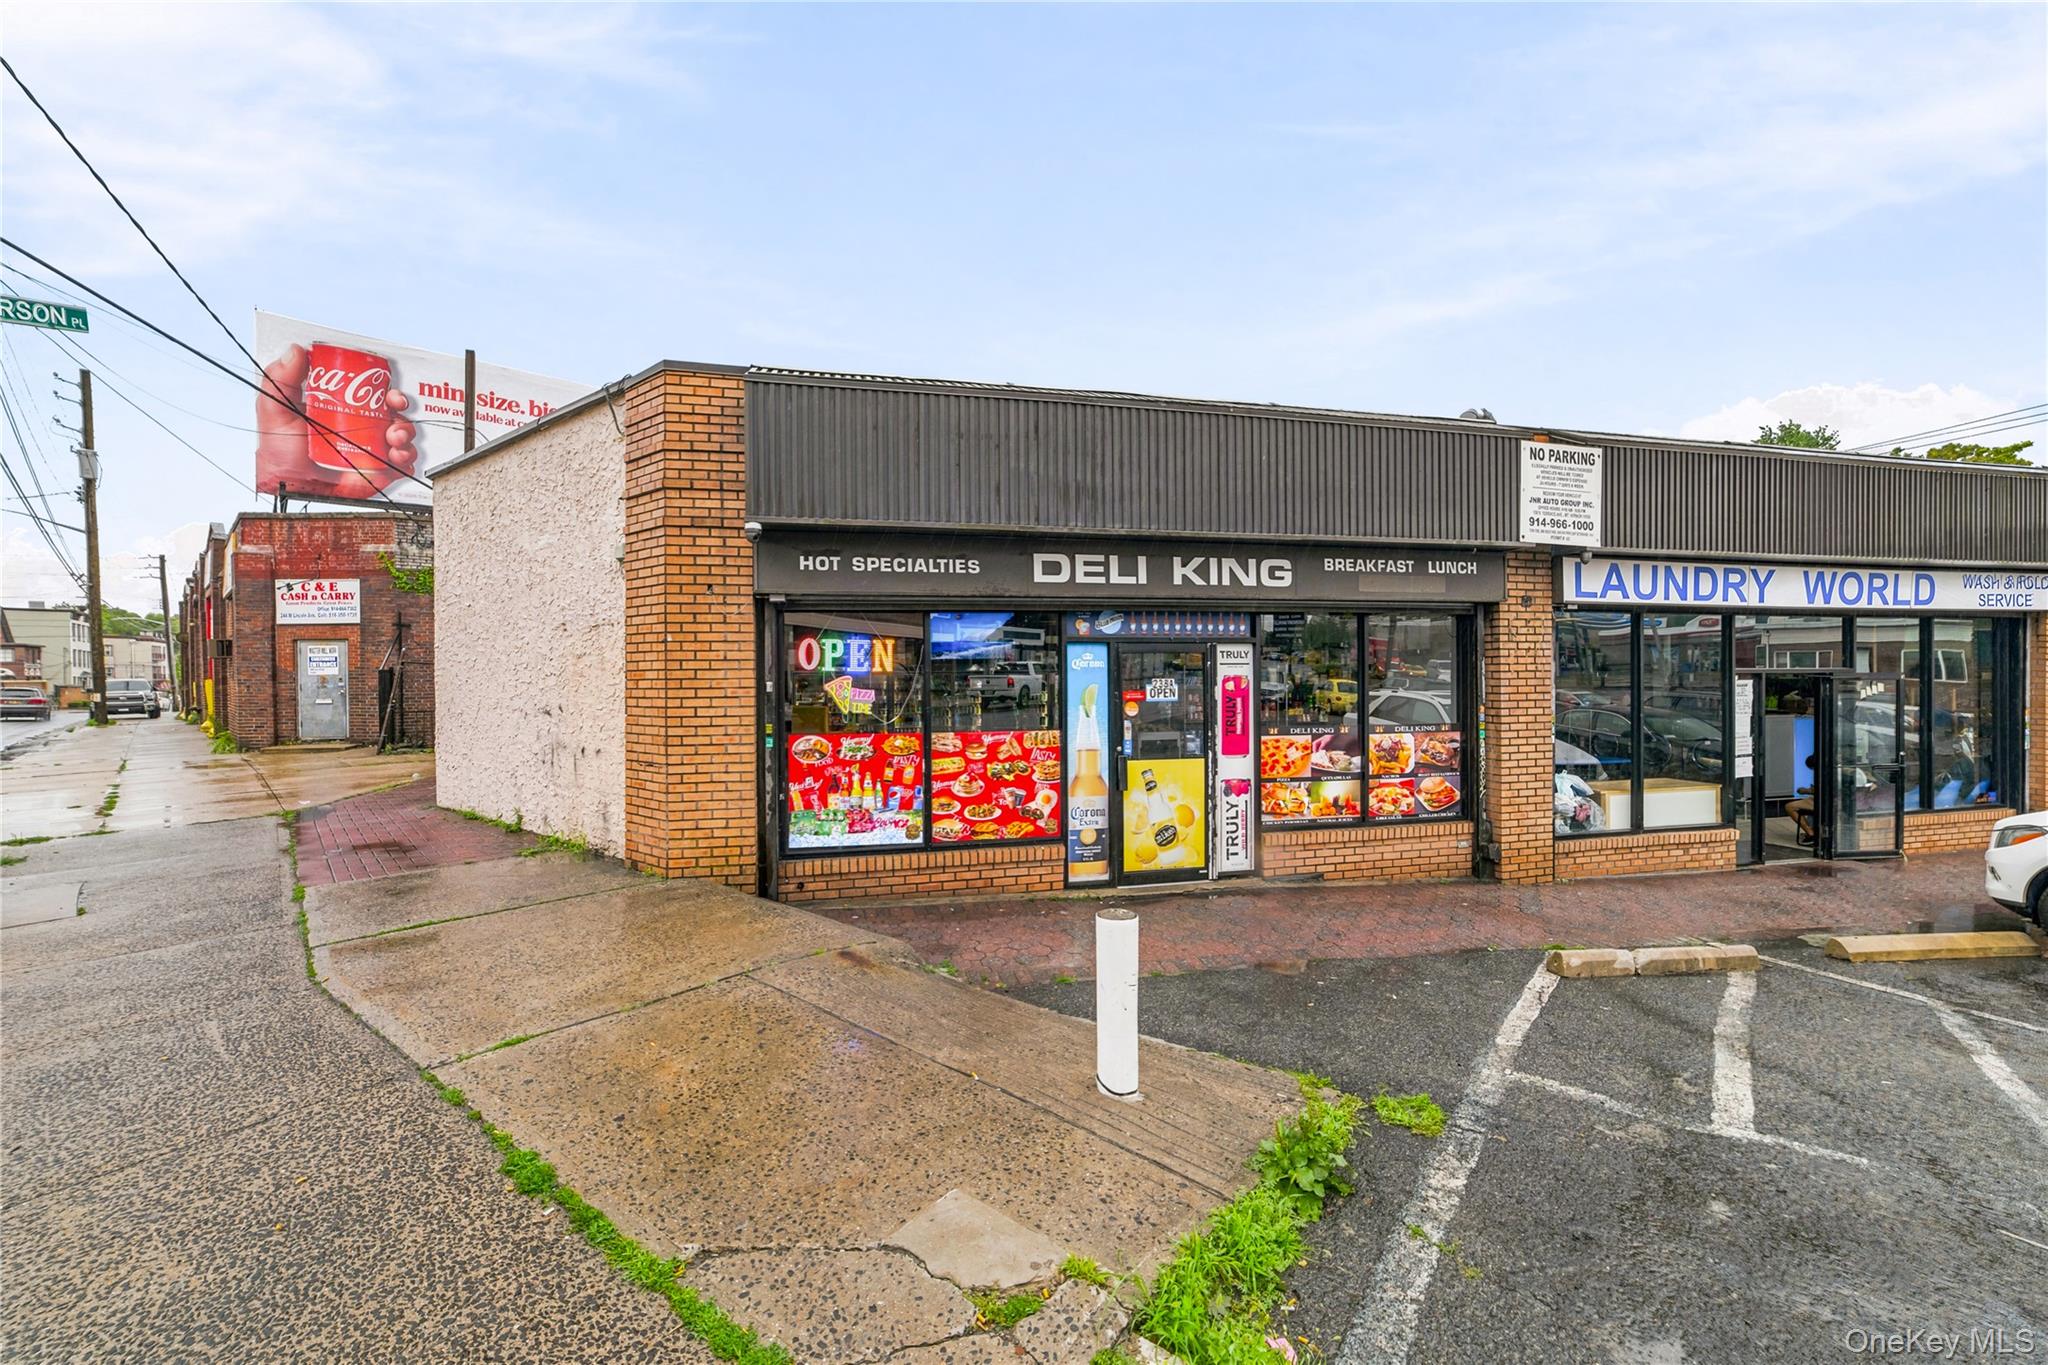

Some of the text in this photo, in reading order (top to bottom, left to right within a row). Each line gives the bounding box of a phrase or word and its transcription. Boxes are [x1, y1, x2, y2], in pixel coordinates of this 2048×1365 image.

[71, 317, 87, 329] PL
[419, 382, 465, 403] min
[476, 391, 525, 415] size.
[314, 402, 355, 414] ORIGINAL
[425, 403, 451, 416] now
[452, 408, 504, 424] avlable
[505, 418, 516, 427] at
[1530, 447, 1596, 466] NO PARKING
[1543, 498, 1559, 506] AUTO
[1560, 499, 1581, 507] GROUP
[1583, 501, 1595, 509] INC.
[1529, 516, 1594, 531] 914-966-1000
[799, 556, 981, 574] HOT SPECIALTIES
[1033, 553, 1293, 588] DELI KING
[1324, 558, 1478, 575] BREAKFAST LUNCH
[301, 582, 338, 592] C & E
[1574, 561, 1936, 606] LAUNDRY WORLD
[280, 592, 308, 601] CASH
[320, 592, 356, 601] CARRY
[1978, 594, 2033, 607] SERVICE
[798, 637, 895, 672] OPEN
[1220, 650, 1250, 659] TRULY
[1149, 688, 1176, 698] OPEN
[852, 702, 872, 714] TIME
[1226, 696, 1236, 736] TRULY
[1071, 806, 1106, 820] Corona
[1080, 818, 1099, 826] Extra
[1226, 801, 1239, 860] TRULY
